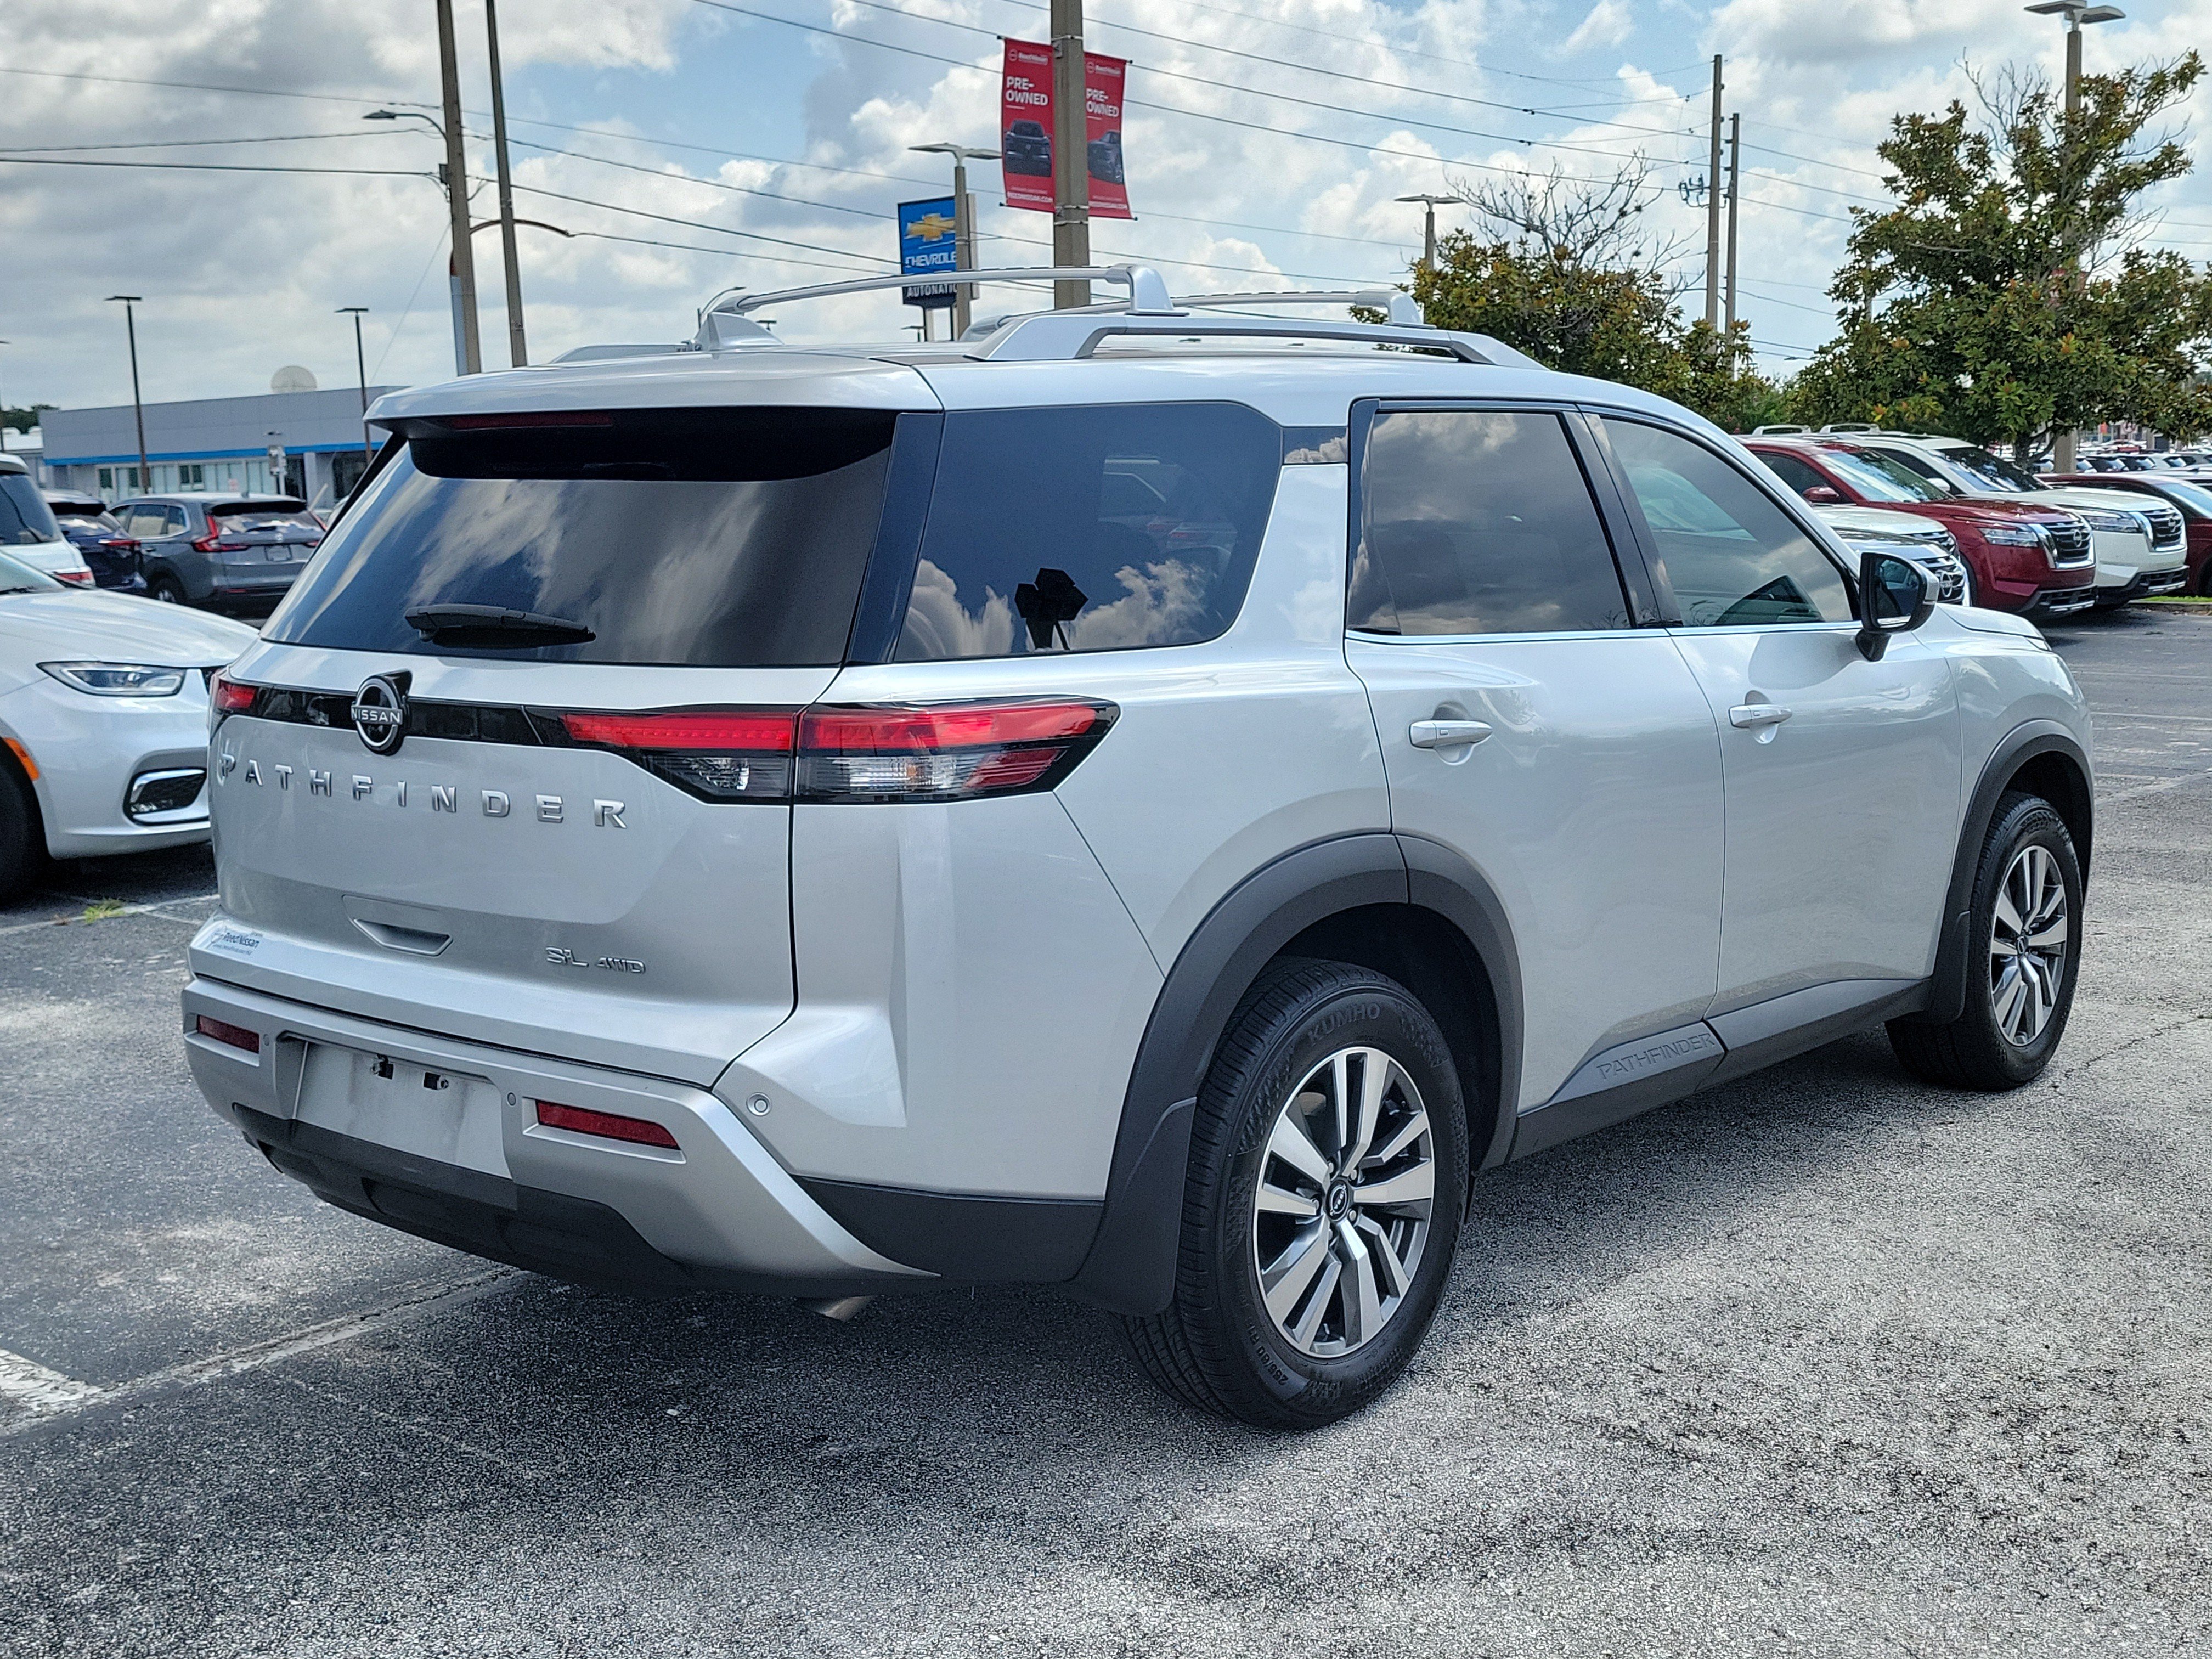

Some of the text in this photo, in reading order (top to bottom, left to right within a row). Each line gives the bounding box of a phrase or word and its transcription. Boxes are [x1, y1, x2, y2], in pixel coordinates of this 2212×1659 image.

[1006, 76, 1035, 91] PRE-
[1006, 89, 1048, 106] OWNED
[1086, 88, 1109, 102] PRE-
[1086, 101, 1120, 117] OWNED
[905, 251, 957, 268] CHEVROLE
[352, 708, 400, 723] NISSAN
[219, 753, 628, 830] PATHFINDER
[545, 946, 589, 968] SL
[1308, 1002, 1380, 1047] KUMHO
[1596, 1032, 1716, 1081] PATHFINDER
